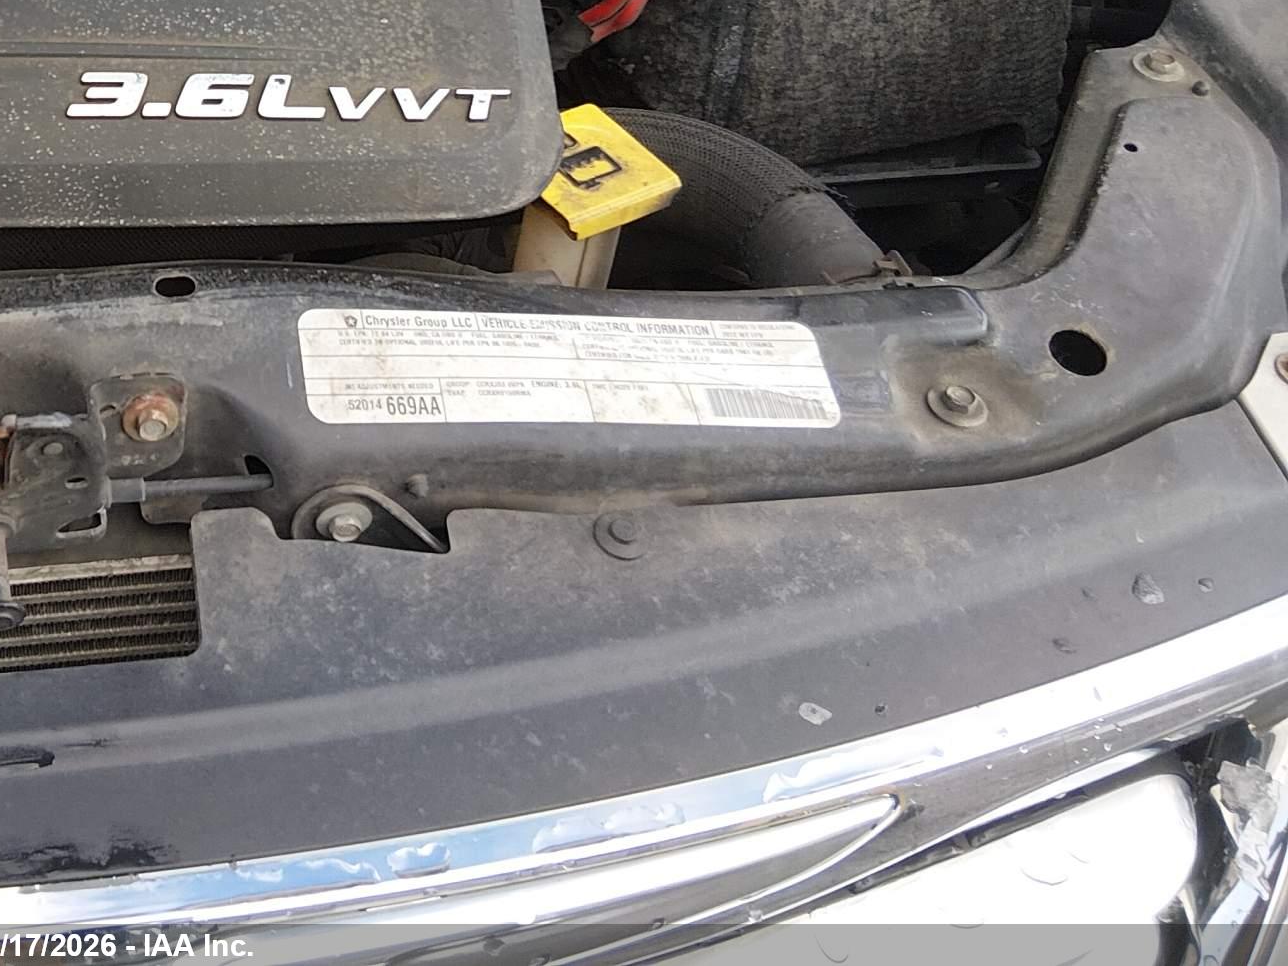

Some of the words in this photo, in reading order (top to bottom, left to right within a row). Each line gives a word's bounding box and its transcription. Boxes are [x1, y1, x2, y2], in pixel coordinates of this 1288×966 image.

[365, 315, 410, 328] Chrysler
[414, 316, 448, 329] Group
[450, 317, 473, 328] LLC
[481, 318, 525, 329] VEHICLE
[636, 324, 710, 337] INFORMATION
[348, 399, 382, 411] 52014
[386, 396, 442, 416] 669AA
